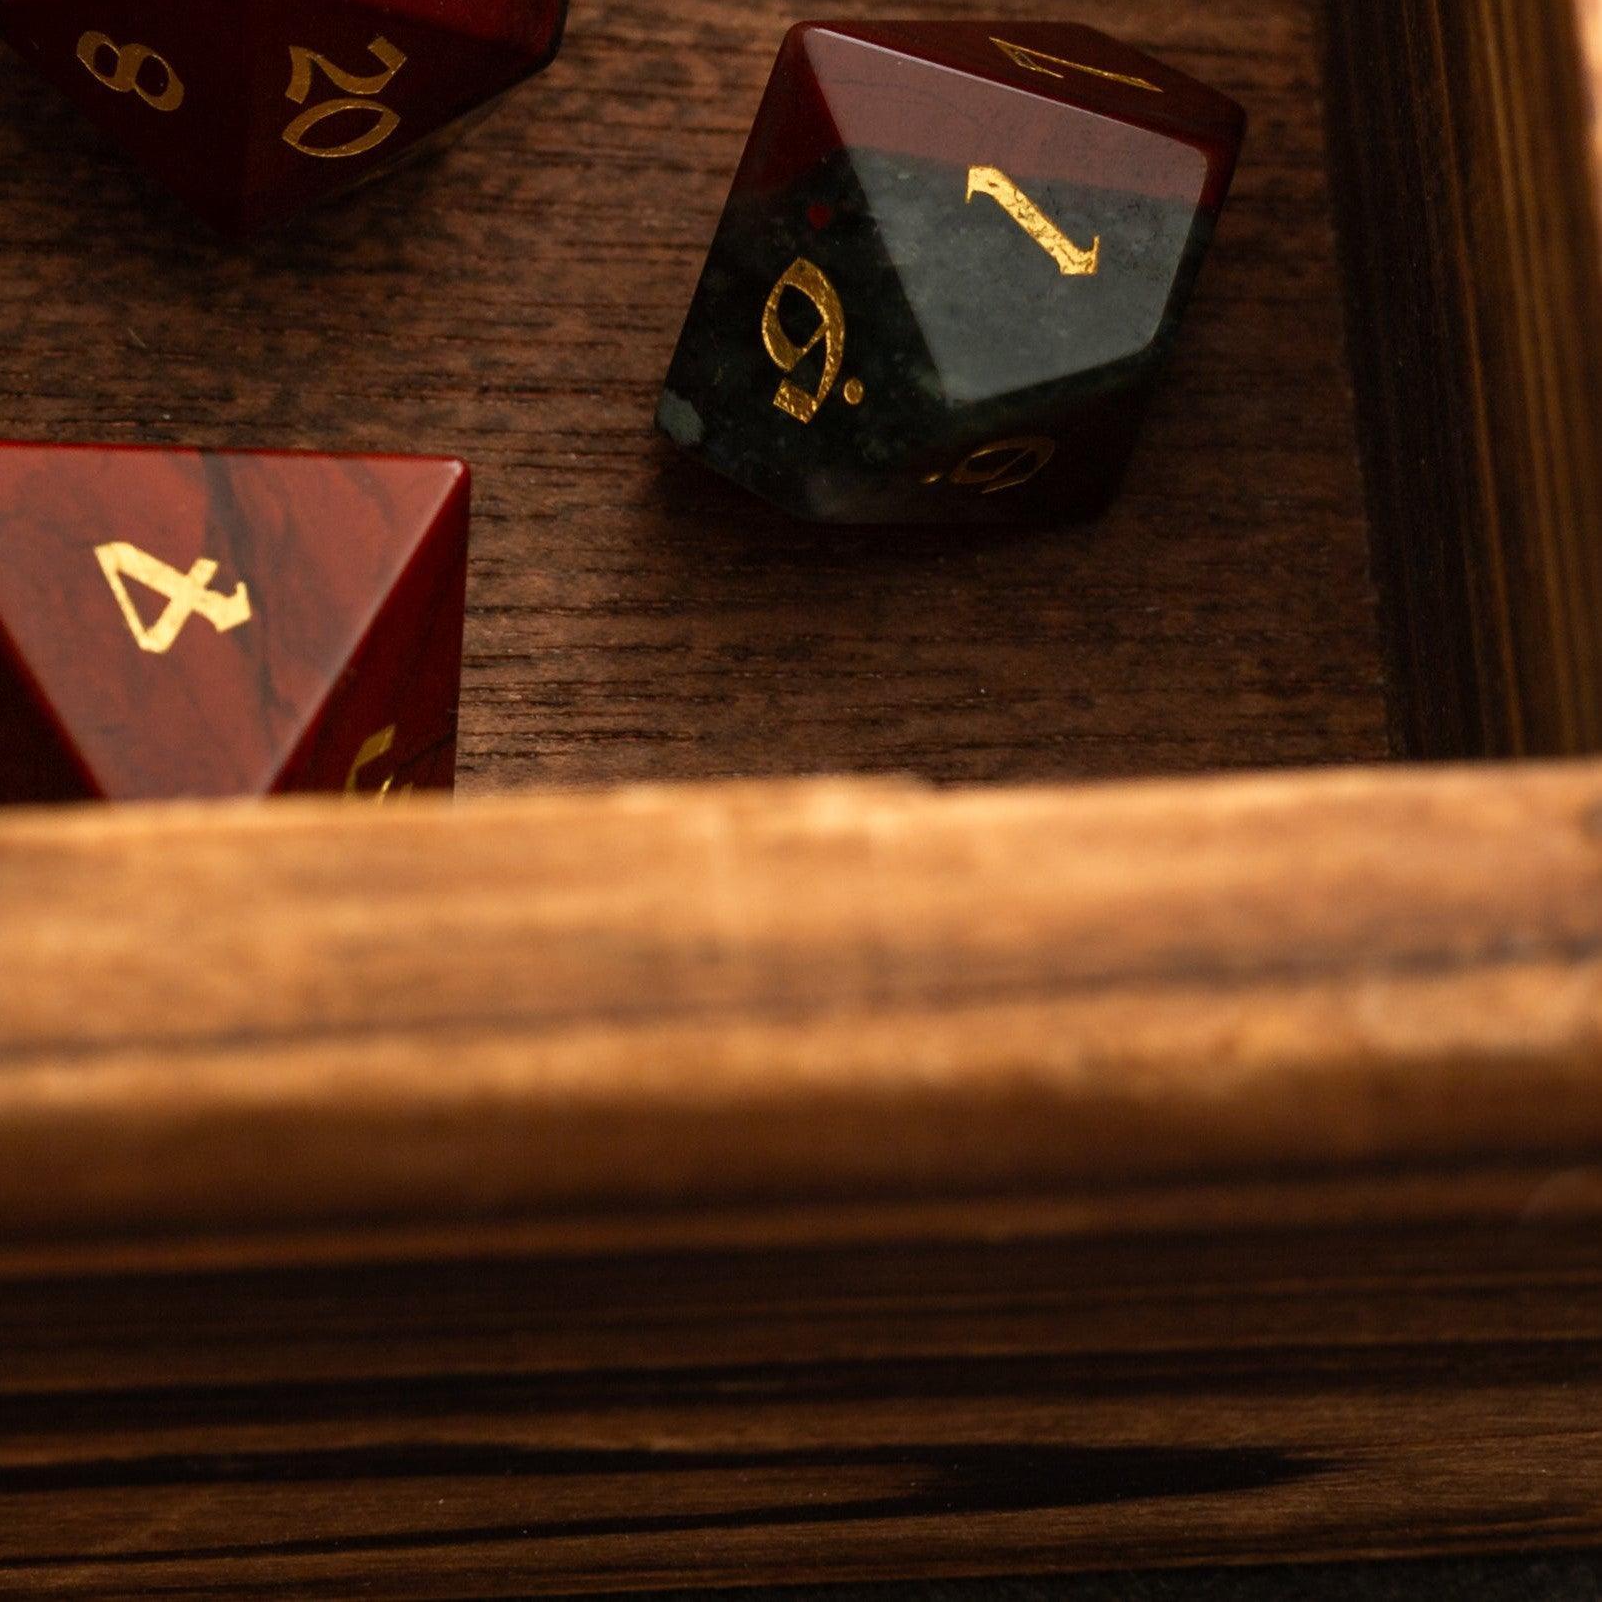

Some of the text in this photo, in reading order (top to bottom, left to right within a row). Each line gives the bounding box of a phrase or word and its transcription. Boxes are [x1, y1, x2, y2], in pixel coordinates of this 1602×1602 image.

[75, 29, 185, 113] 8
[281, 35, 408, 159] 20
[965, 164, 1101, 277] 1
[94, 540, 253, 655] 4
